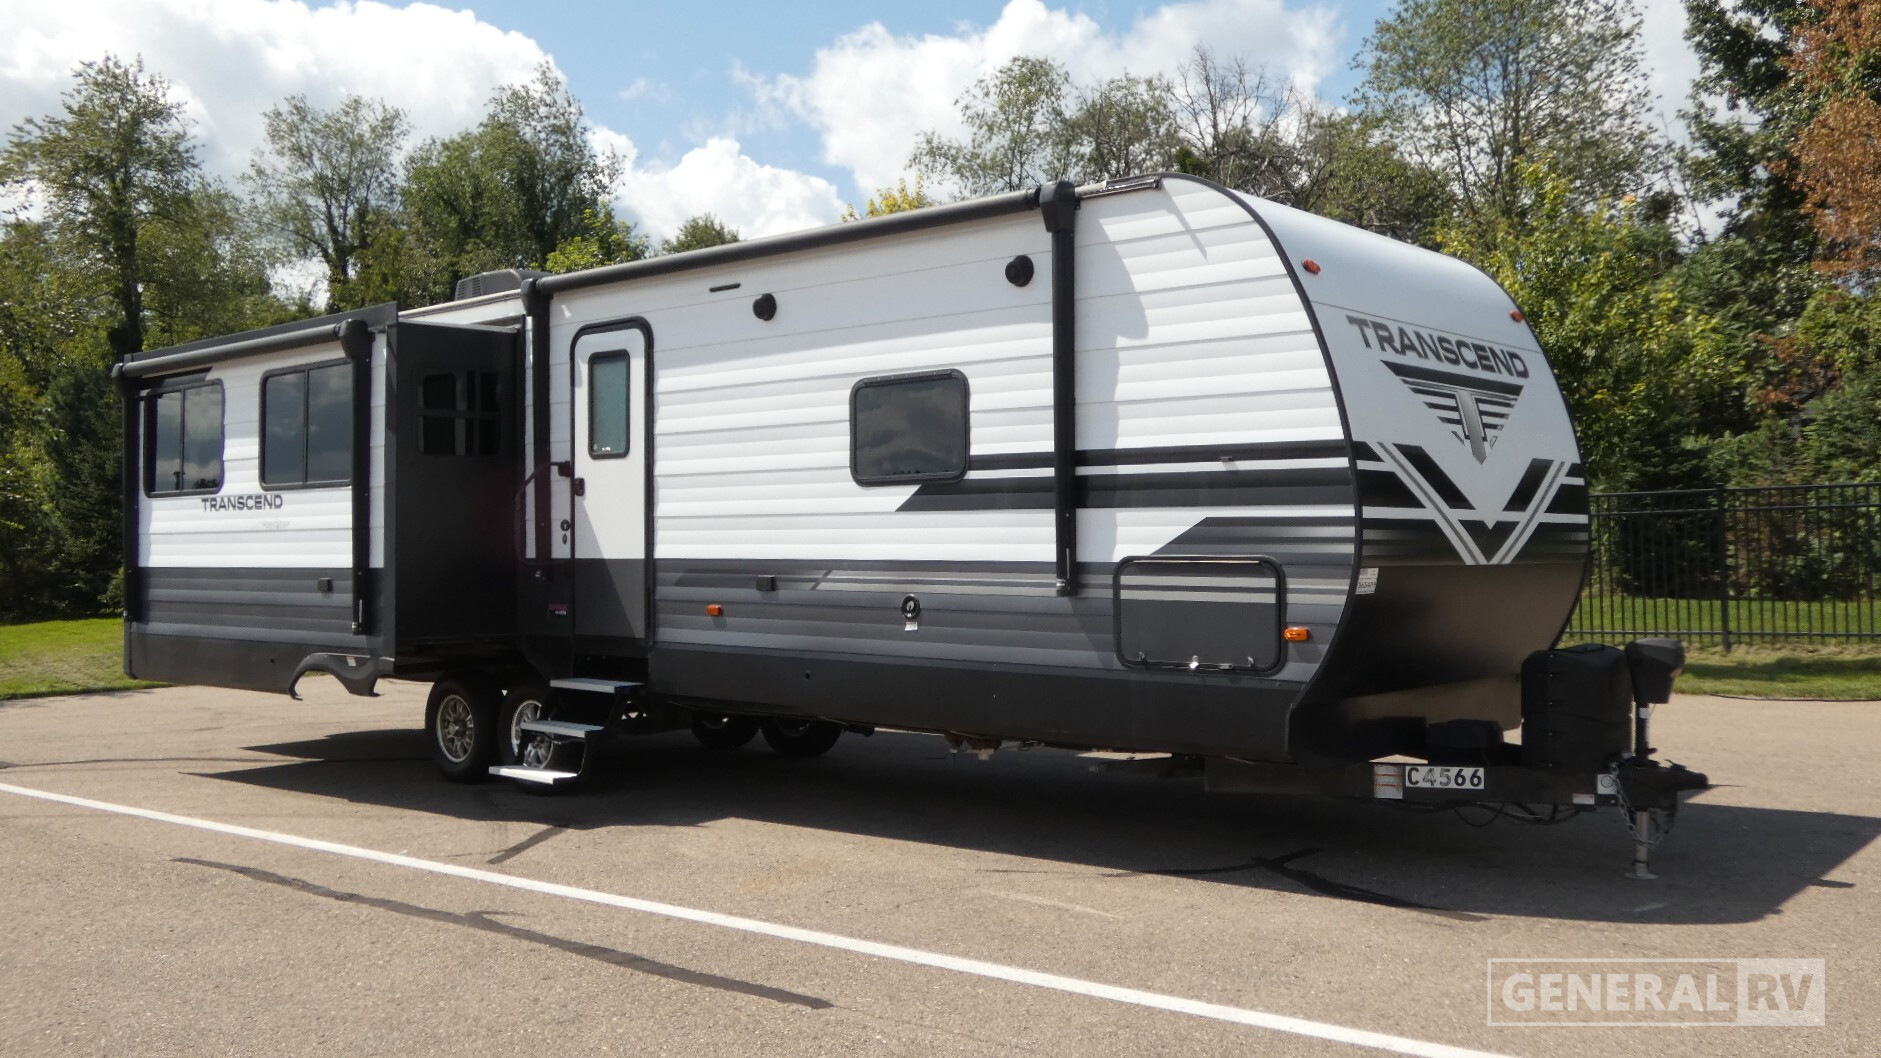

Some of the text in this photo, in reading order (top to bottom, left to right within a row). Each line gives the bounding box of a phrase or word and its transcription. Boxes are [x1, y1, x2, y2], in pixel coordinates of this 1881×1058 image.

[1345, 314, 1530, 379] TRANSCEND
[201, 494, 284, 512] TRANSCEND
[1407, 767, 1482, 788] C4566
